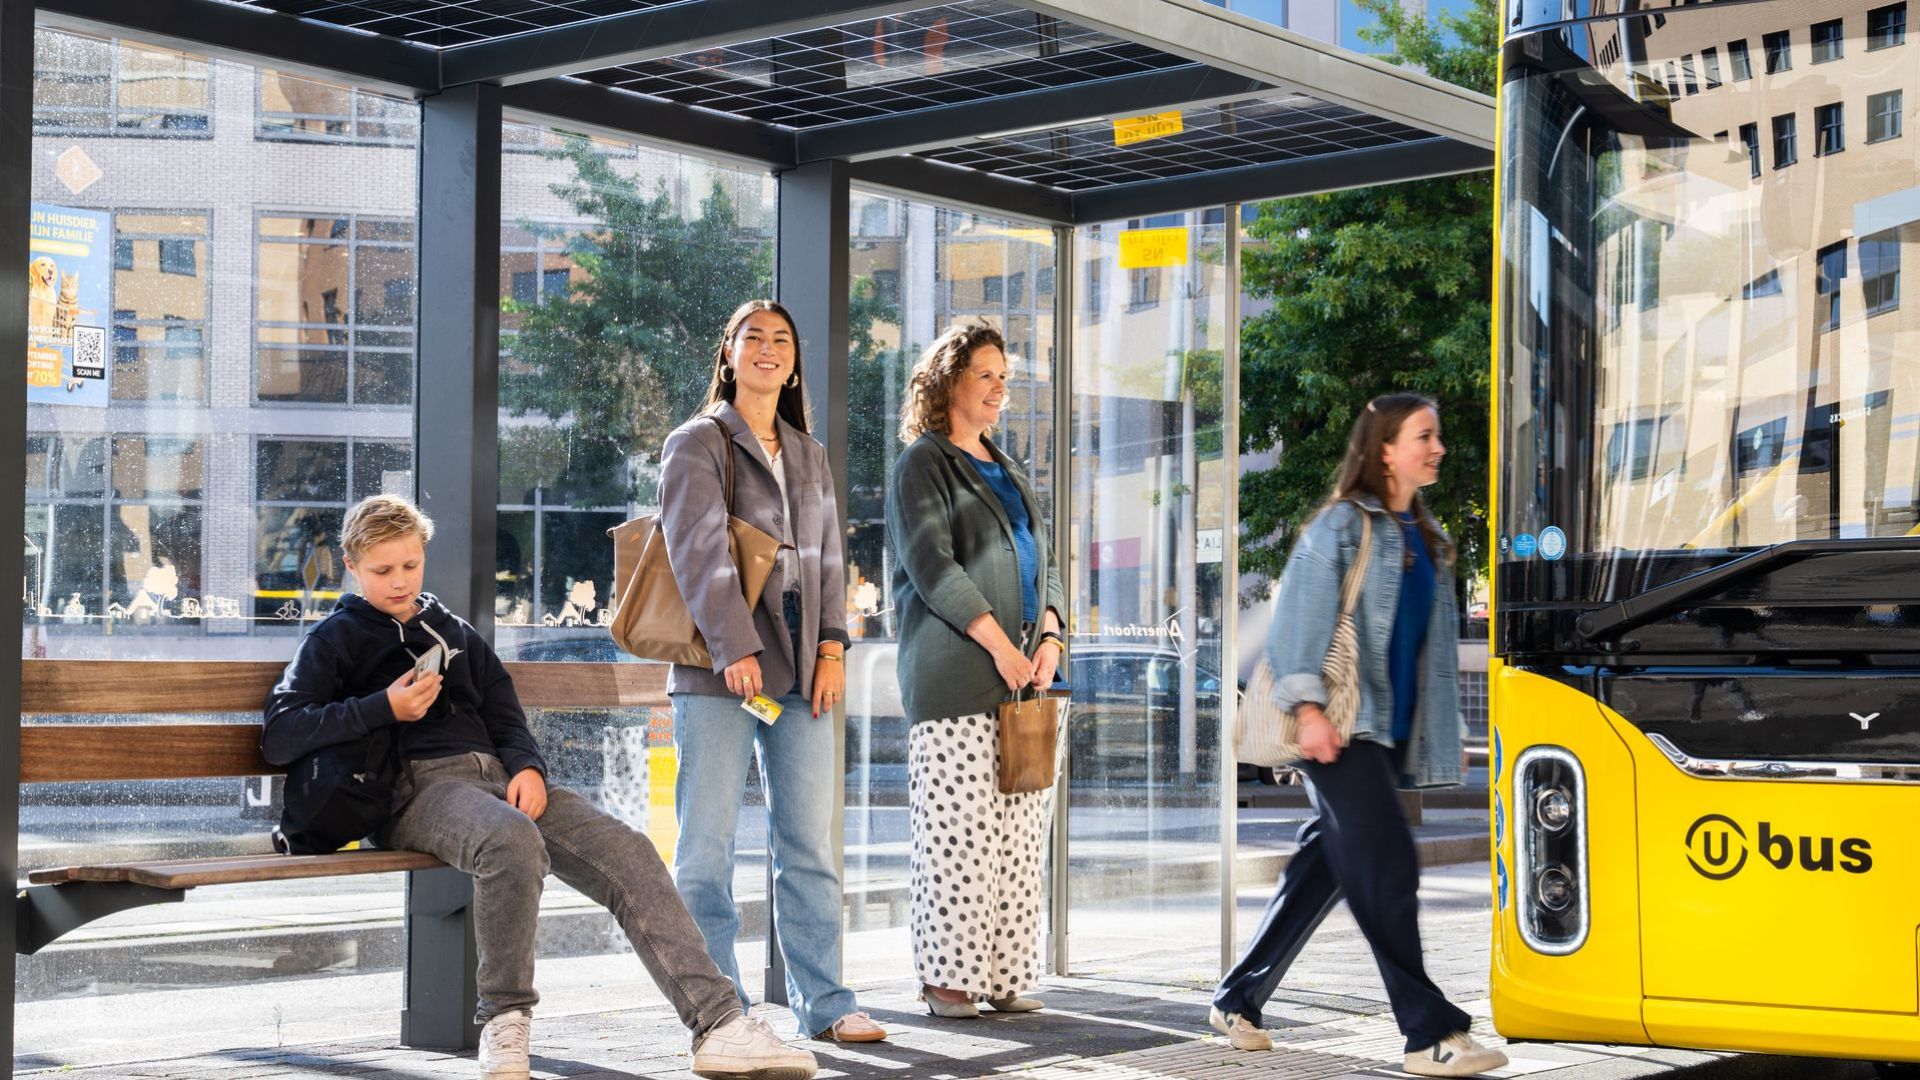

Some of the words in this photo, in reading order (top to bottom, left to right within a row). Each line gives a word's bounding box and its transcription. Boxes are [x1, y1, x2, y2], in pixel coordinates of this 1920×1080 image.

[31, 210, 45, 223] JN
[52, 226, 94, 242] FAMILIE
[34, 370, 58, 385] 70%
[76, 369, 92, 377] SCAN
[1758, 821, 1873, 874] bus
